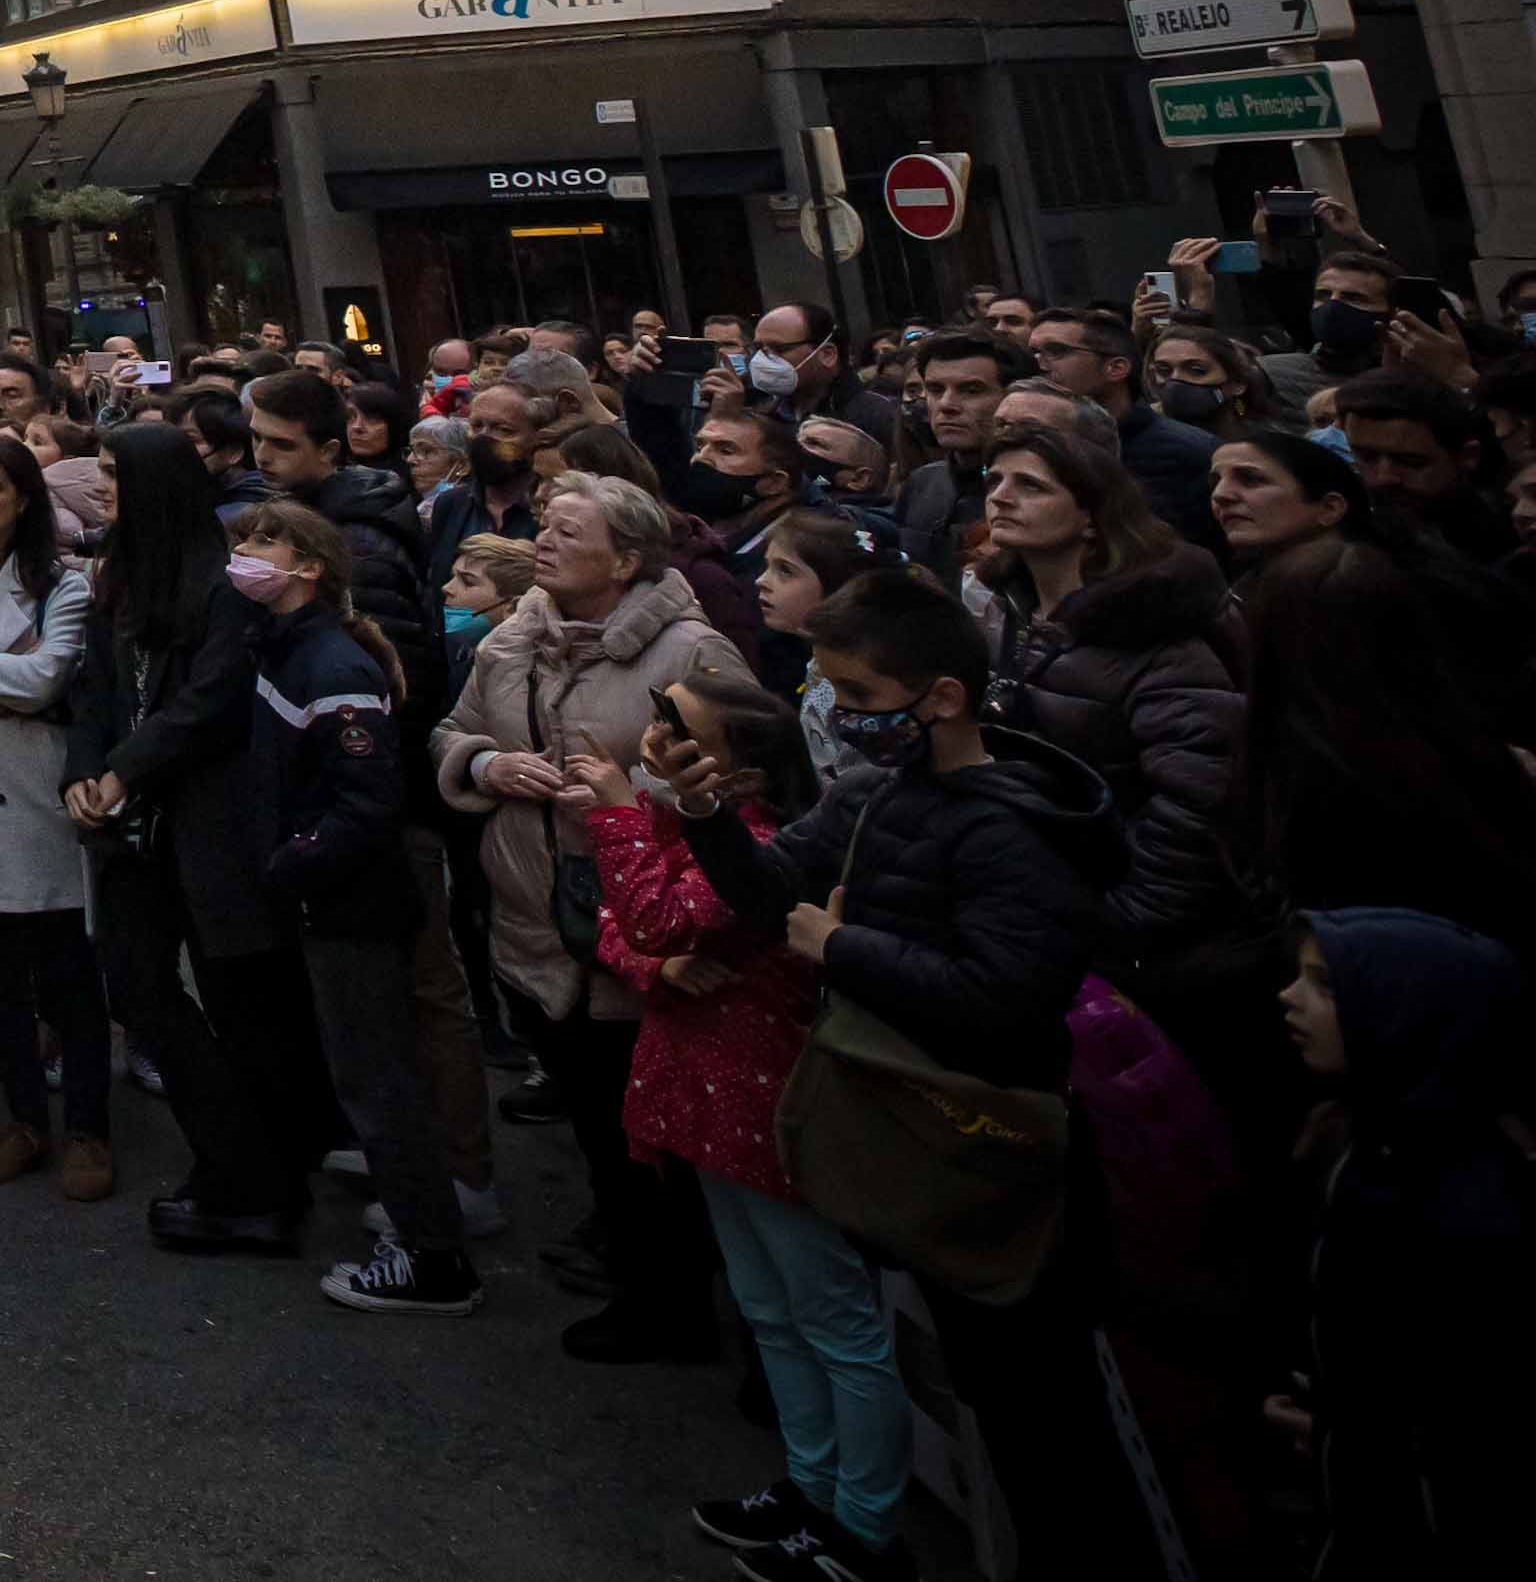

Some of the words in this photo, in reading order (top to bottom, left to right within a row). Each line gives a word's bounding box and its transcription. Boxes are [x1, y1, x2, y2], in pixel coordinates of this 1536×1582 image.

[1156, 2, 1231, 35] REALEJO
[1163, 99, 1209, 125] Campo
[1215, 95, 1239, 119] del
[488, 168, 608, 189] BONGO
